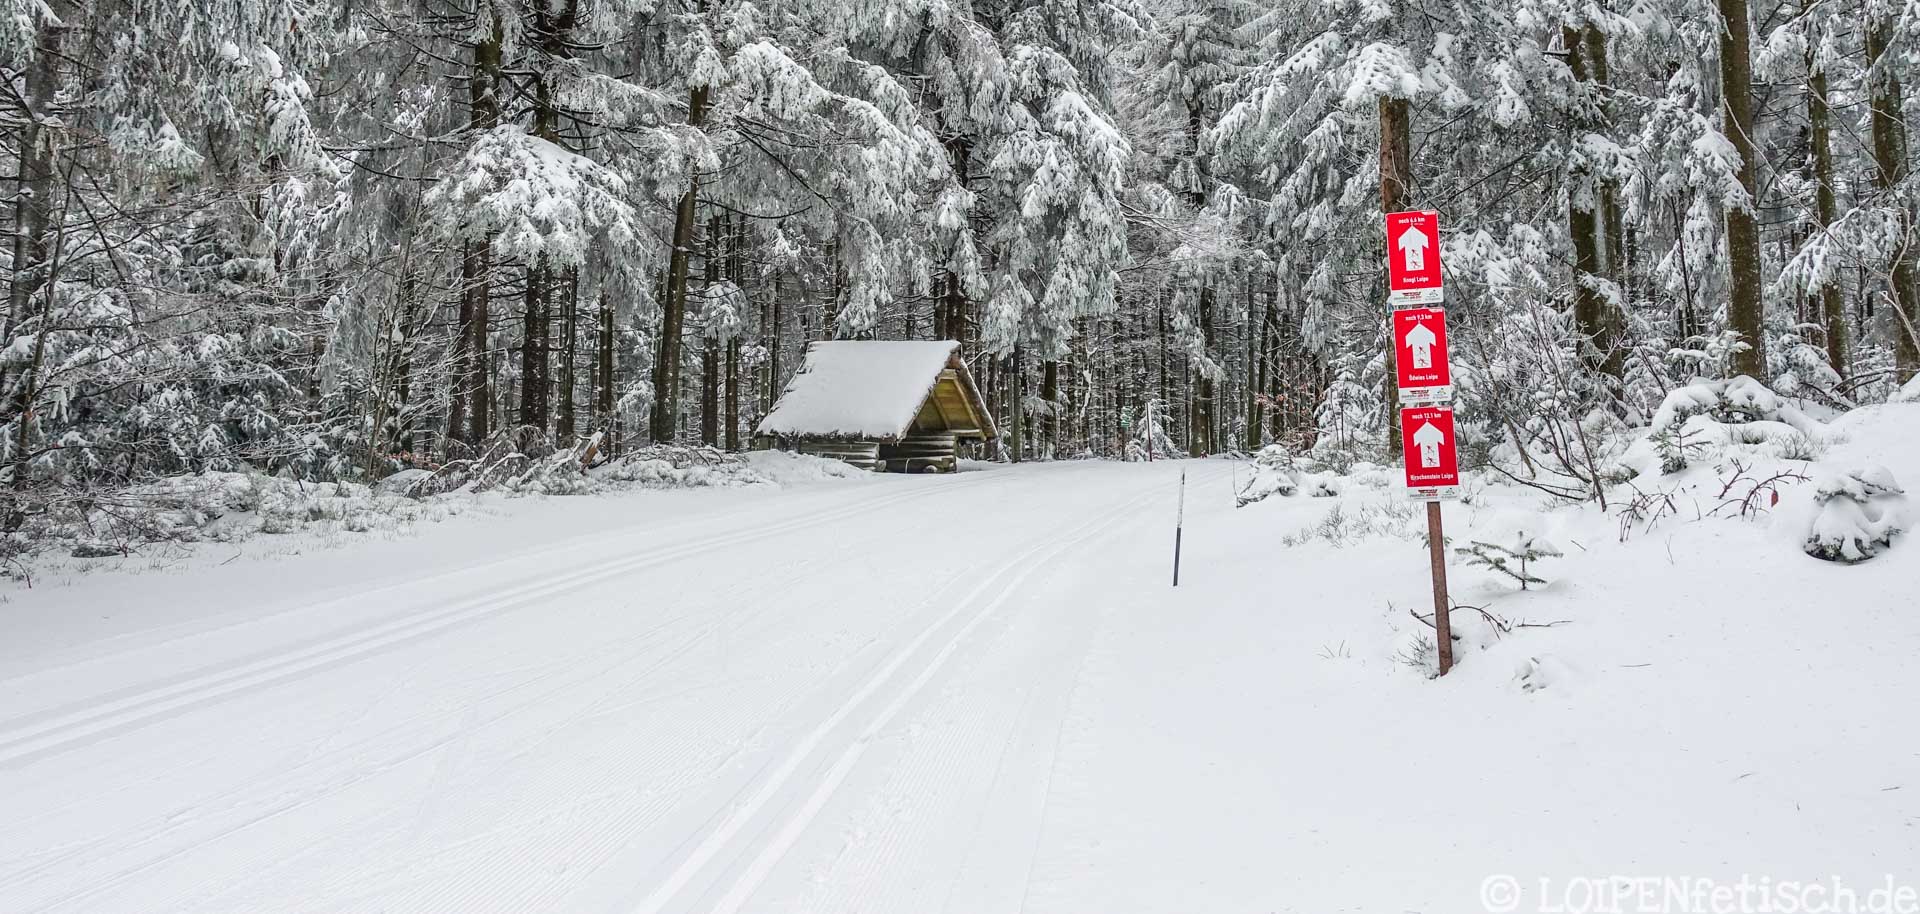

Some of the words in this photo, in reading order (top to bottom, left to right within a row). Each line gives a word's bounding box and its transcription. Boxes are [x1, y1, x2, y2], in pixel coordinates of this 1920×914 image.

[1416, 275, 1429, 283] Loipe
[1425, 373, 1439, 381] Loipe
[1441, 472, 1454, 480] Loipe
